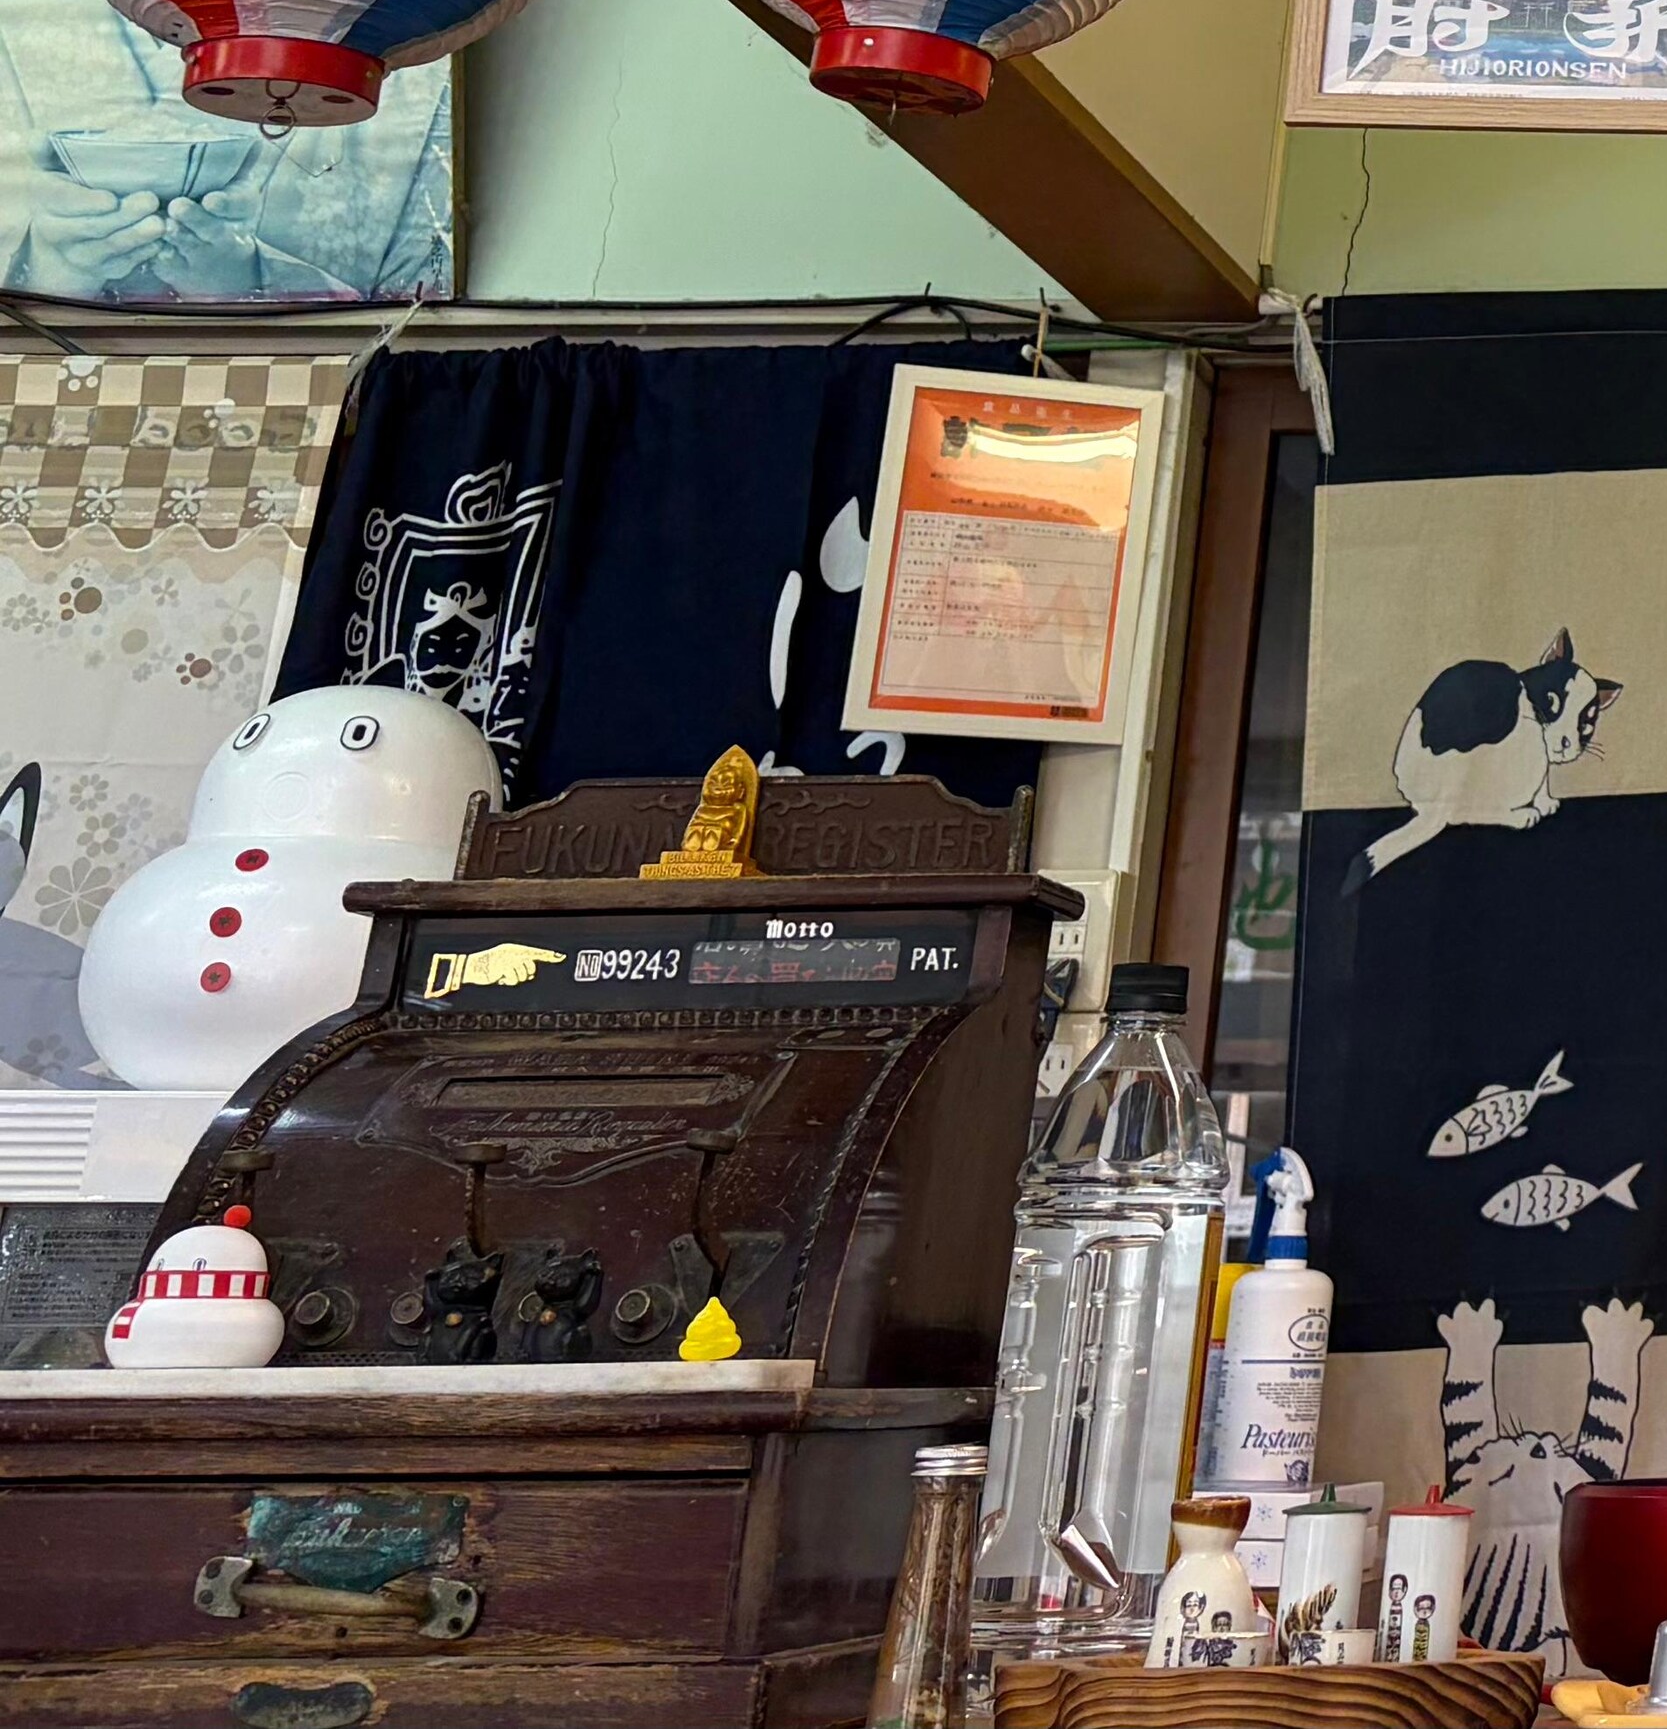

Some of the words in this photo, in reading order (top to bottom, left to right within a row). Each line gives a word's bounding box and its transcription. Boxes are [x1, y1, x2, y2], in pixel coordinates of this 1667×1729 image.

[766, 918, 834, 939] Motto
[601, 949, 680, 981] 99243
[911, 947, 960, 972] PAT.
